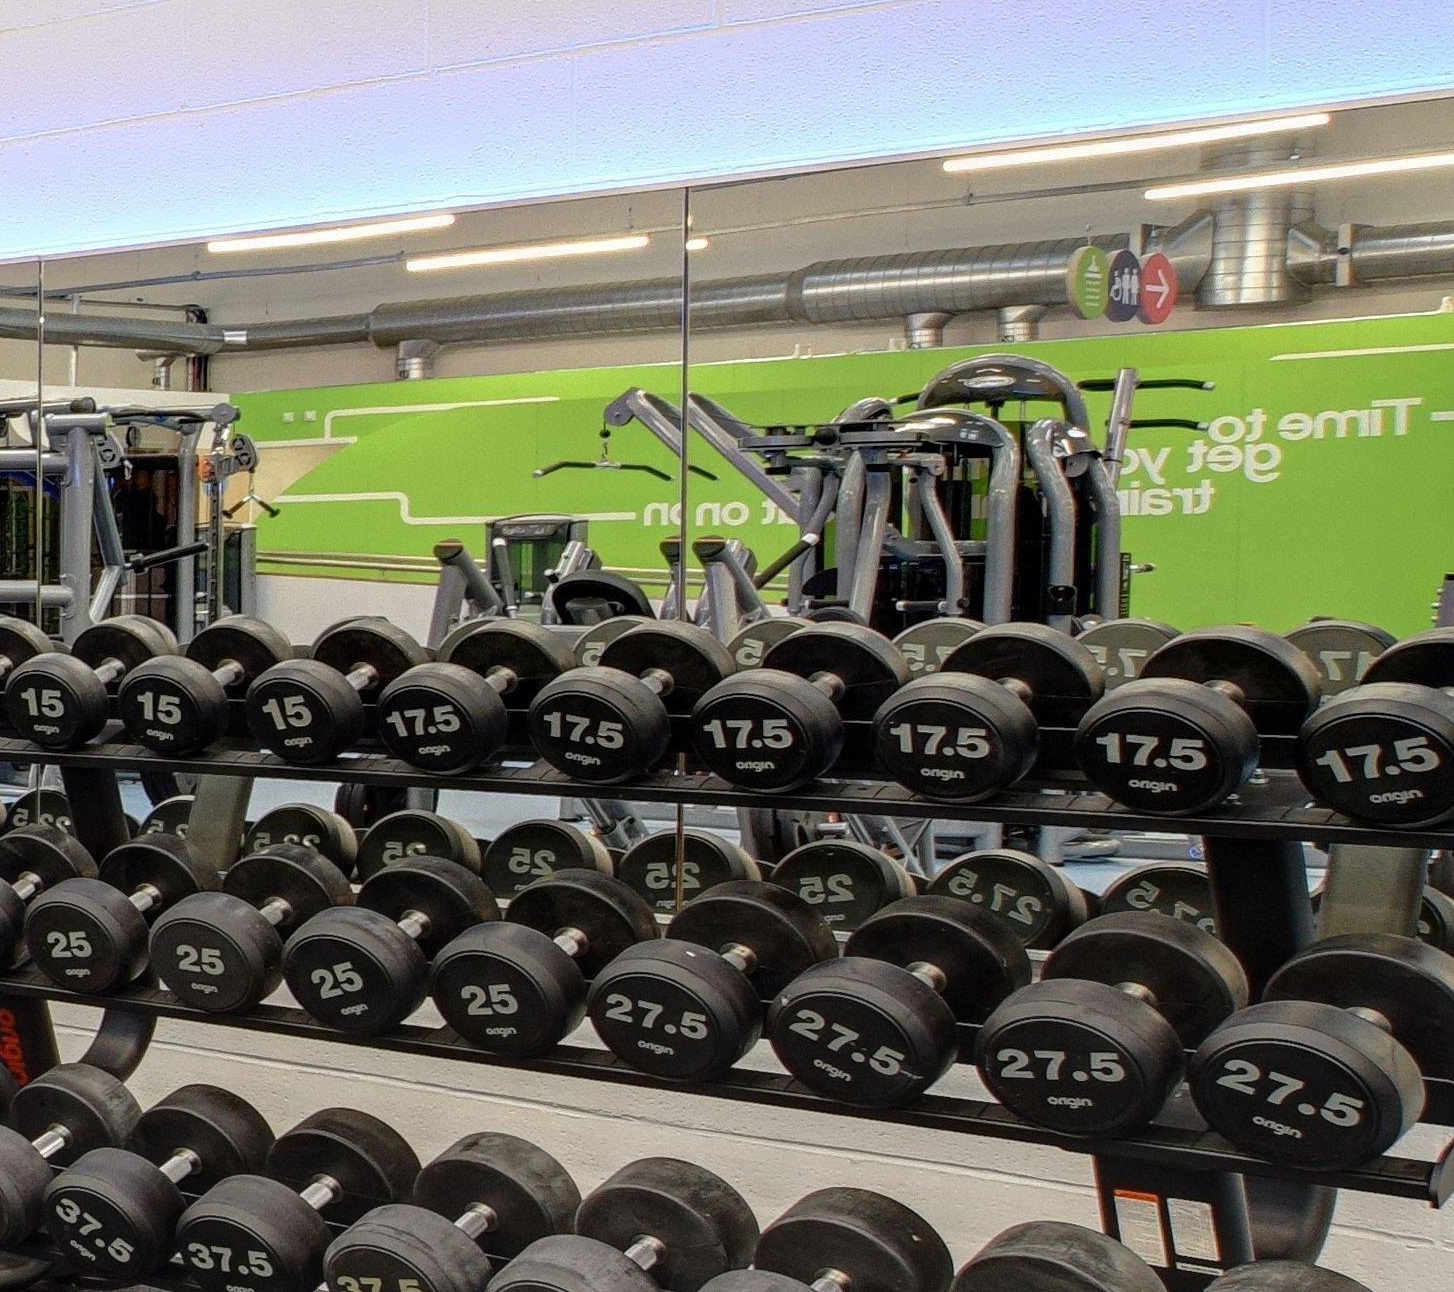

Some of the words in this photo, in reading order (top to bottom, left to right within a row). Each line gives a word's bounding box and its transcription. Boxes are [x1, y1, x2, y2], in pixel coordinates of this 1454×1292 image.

[21, 688, 64, 717] 15
[137, 691, 181, 724] 15
[262, 695, 312, 730] 15
[386, 705, 460, 736] 17.5
[544, 712, 623, 748] 17.5
[703, 719, 793, 748] 17.5
[890, 724, 990, 758] 17.5
[1096, 733, 1206, 770] 17.5
[919, 767, 966, 782] origin
[1316, 737, 1440, 782] 17.5
[1127, 779, 1178, 794] origin
[1369, 789, 1424, 805] origin
[47, 931, 92, 957] 25
[177, 945, 224, 975] 25
[311, 962, 363, 999] 25
[461, 984, 518, 1015] 25
[606, 994, 707, 1039] 27.5
[789, 1009, 903, 1076] 27.5
[997, 1049, 1125, 1082] 27.5
[1046, 1096, 1093, 1109] origin
[1216, 1060, 1363, 1126] 27.5
[1252, 1115, 1303, 1139] origin
[56, 1198, 134, 1262] 37.5
[188, 1243, 273, 1276] 37.5
